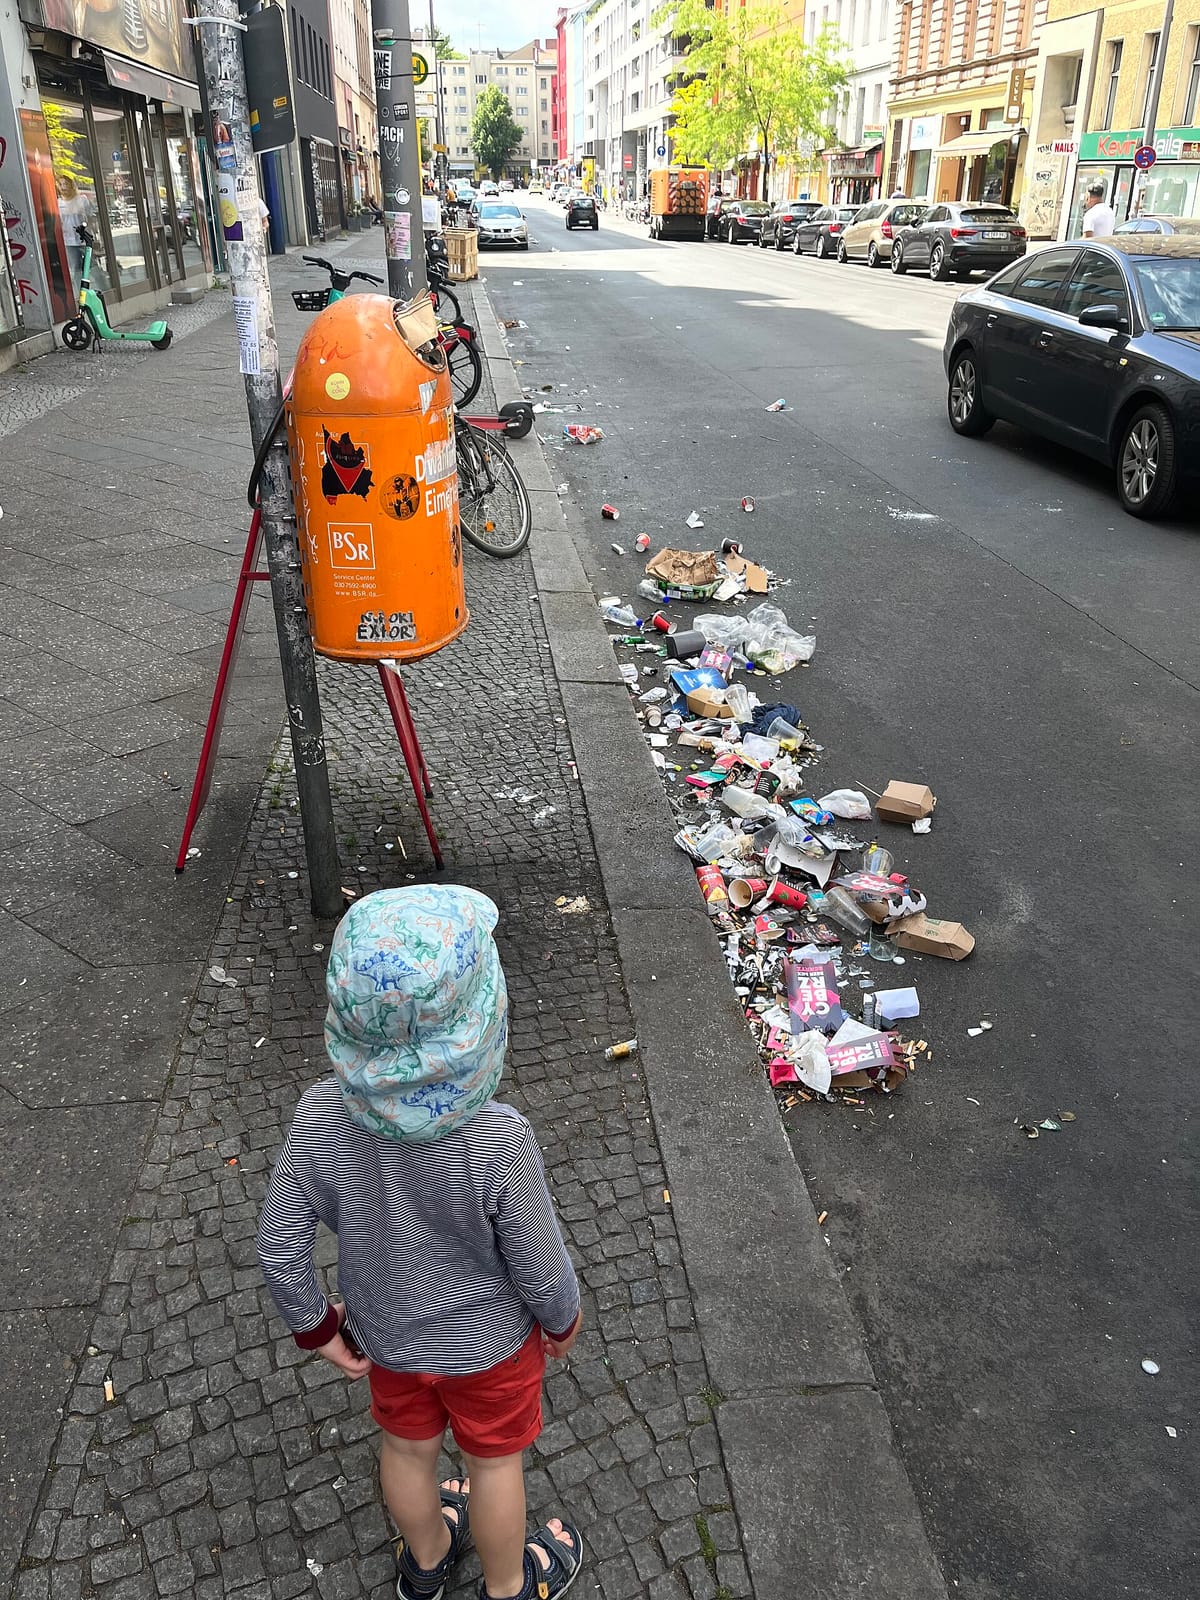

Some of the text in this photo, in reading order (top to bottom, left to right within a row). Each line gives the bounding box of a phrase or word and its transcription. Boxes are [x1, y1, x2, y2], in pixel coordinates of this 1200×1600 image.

[1055, 142, 1074, 153] NAILS
[1152, 132, 1182, 157] ails
[333, 531, 370, 561] BSR
[333, 573, 354, 581] Service
[797, 976, 826, 989] RZ
[800, 989, 828, 1002] BE
[801, 1001, 830, 1016] CY
